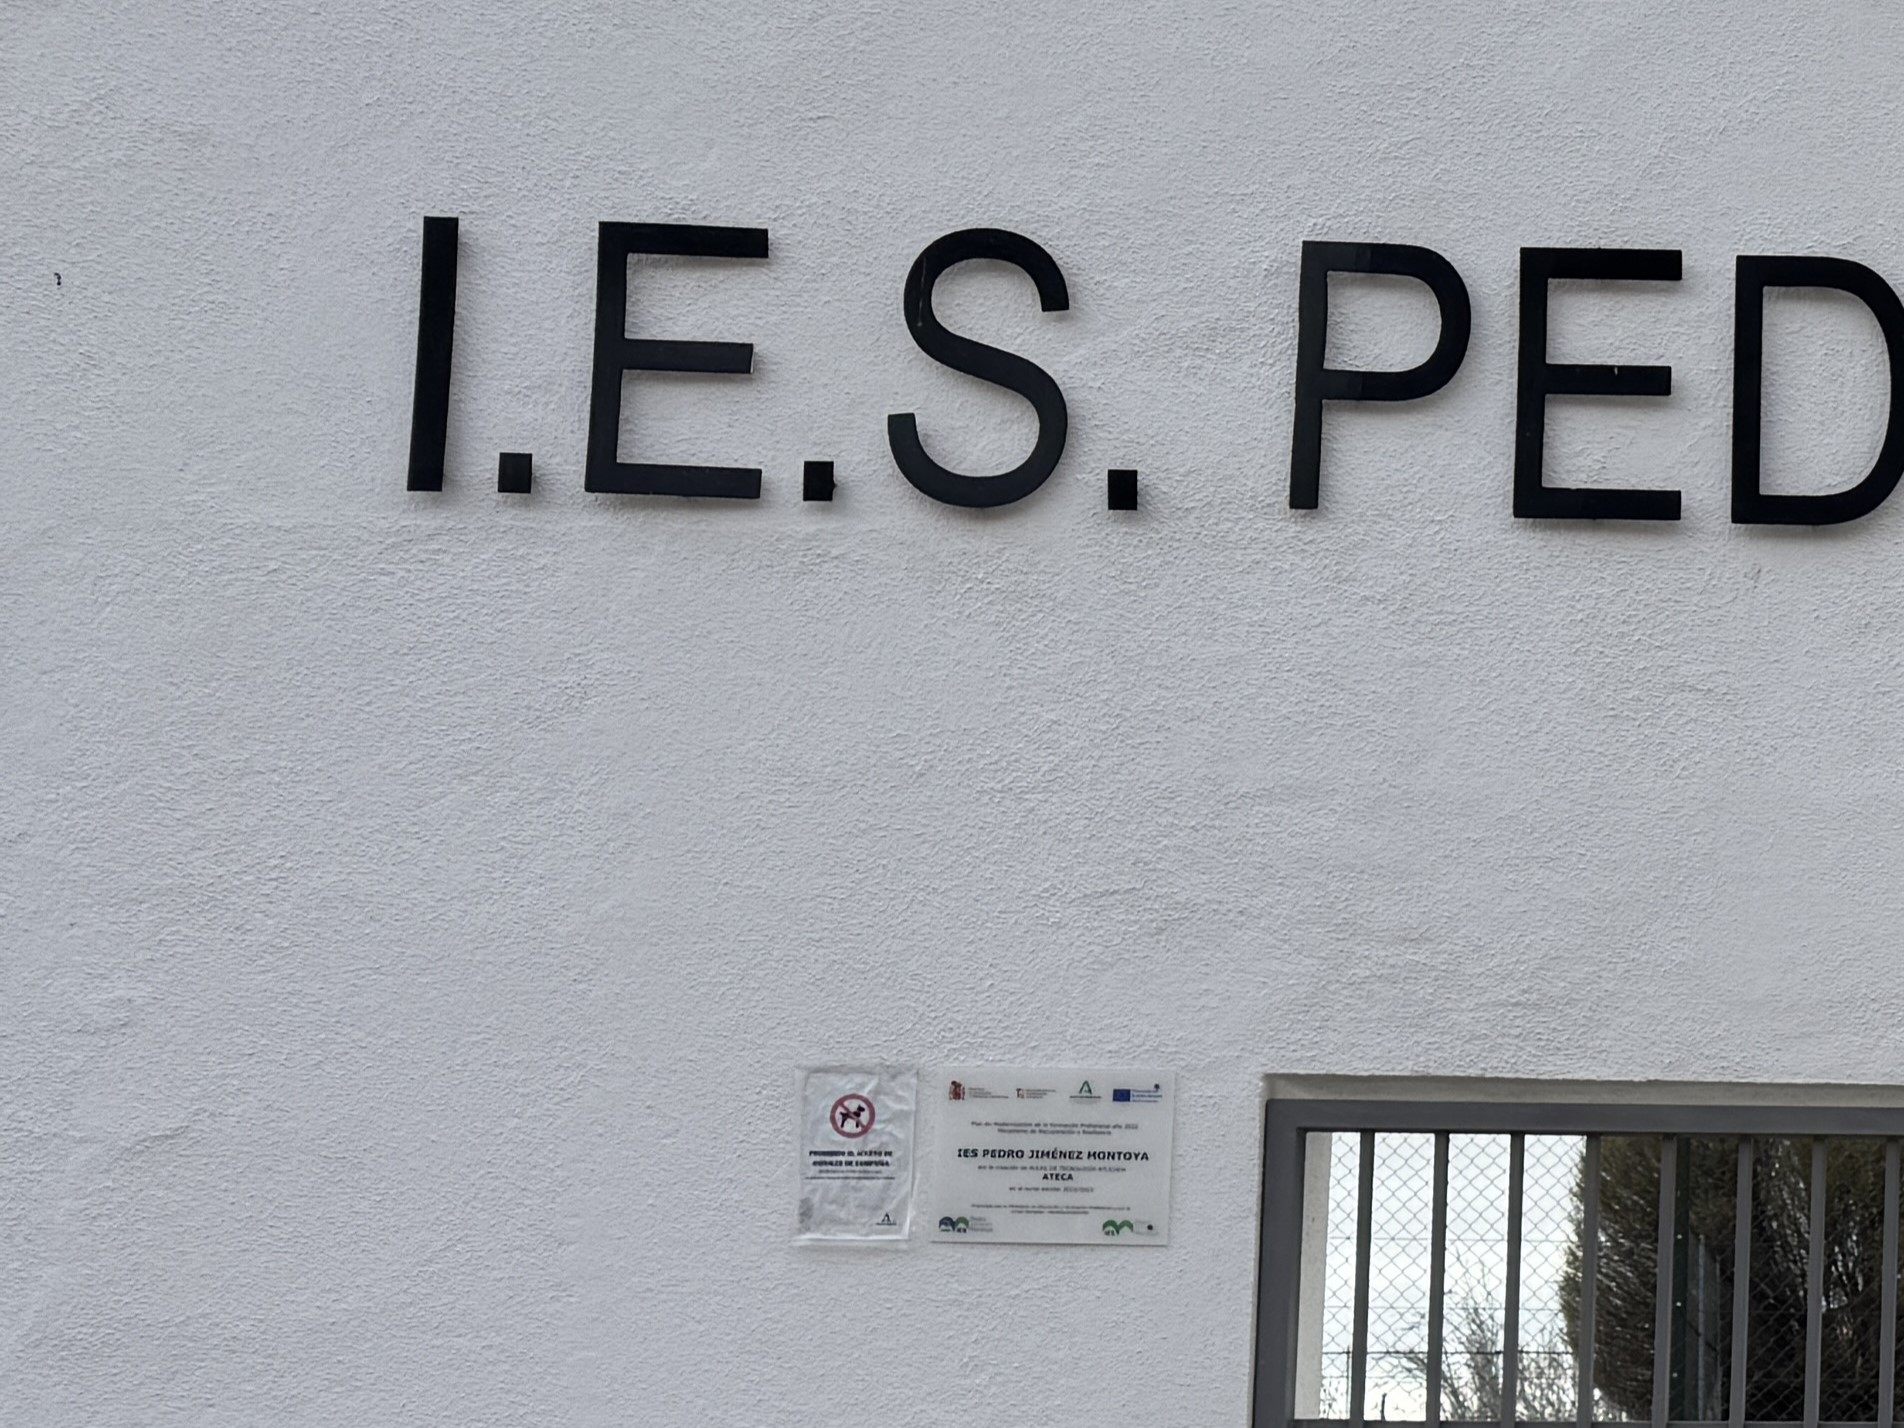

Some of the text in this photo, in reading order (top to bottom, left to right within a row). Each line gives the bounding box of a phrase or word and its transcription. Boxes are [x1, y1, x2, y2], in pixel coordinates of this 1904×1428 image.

[407, 216, 1138, 512] I.E.S.
[957, 1147, 1149, 1161] IES PEDRO JIMÉNEZ MONTOYA
[1042, 1173, 1074, 1181] ATECA
